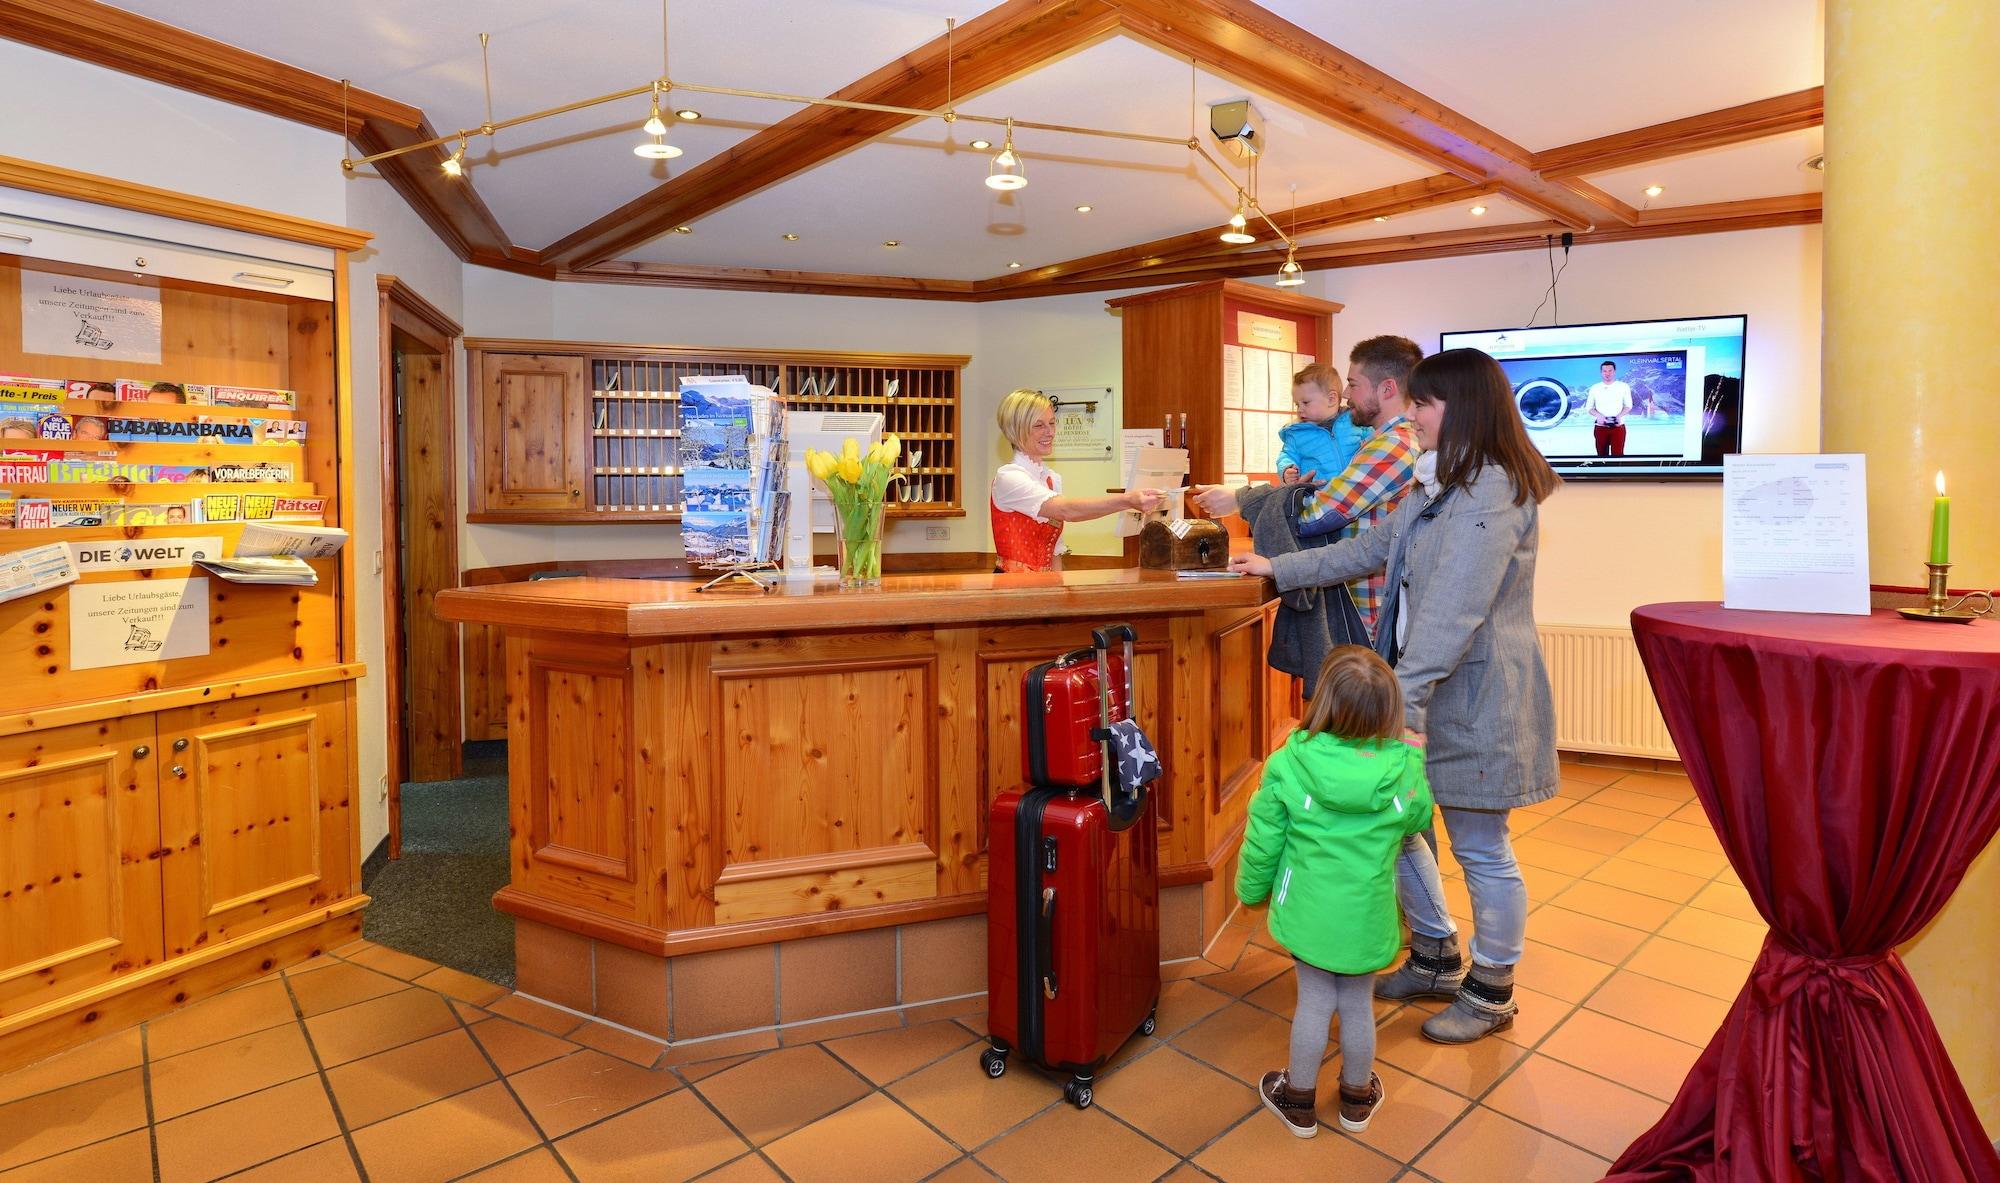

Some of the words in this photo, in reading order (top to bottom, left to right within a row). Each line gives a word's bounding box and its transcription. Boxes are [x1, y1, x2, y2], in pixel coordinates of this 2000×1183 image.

[53, 285, 77, 295] Liebe
[39, 299, 65, 308] unsere
[1629, 356, 1682, 364] KLEINWALSERTAL
[31, 391, 58, 400] Preis
[43, 422, 71, 432] NEUE
[42, 431, 71, 440] BLATT
[215, 467, 290, 480] VORARLBERGERIN
[52, 503, 78, 512] NEUER
[79, 503, 92, 512] VW
[208, 496, 237, 508] NEUE
[246, 496, 275, 508] NEUE
[275, 499, 323, 512] Rätsel
[20, 504, 48, 520] Auto
[209, 508, 236, 520] WELT
[246, 508, 273, 519] WELT
[79, 550, 112, 563] DIE
[102, 594, 126, 602] Liebe
[128, 590, 182, 601] Urlaubsgäste,
[87, 609, 116, 617] unsere
[117, 605, 158, 616] Zeitungen
[160, 603, 176, 612] sind
[121, 614, 164, 624] Verkauf!!!
